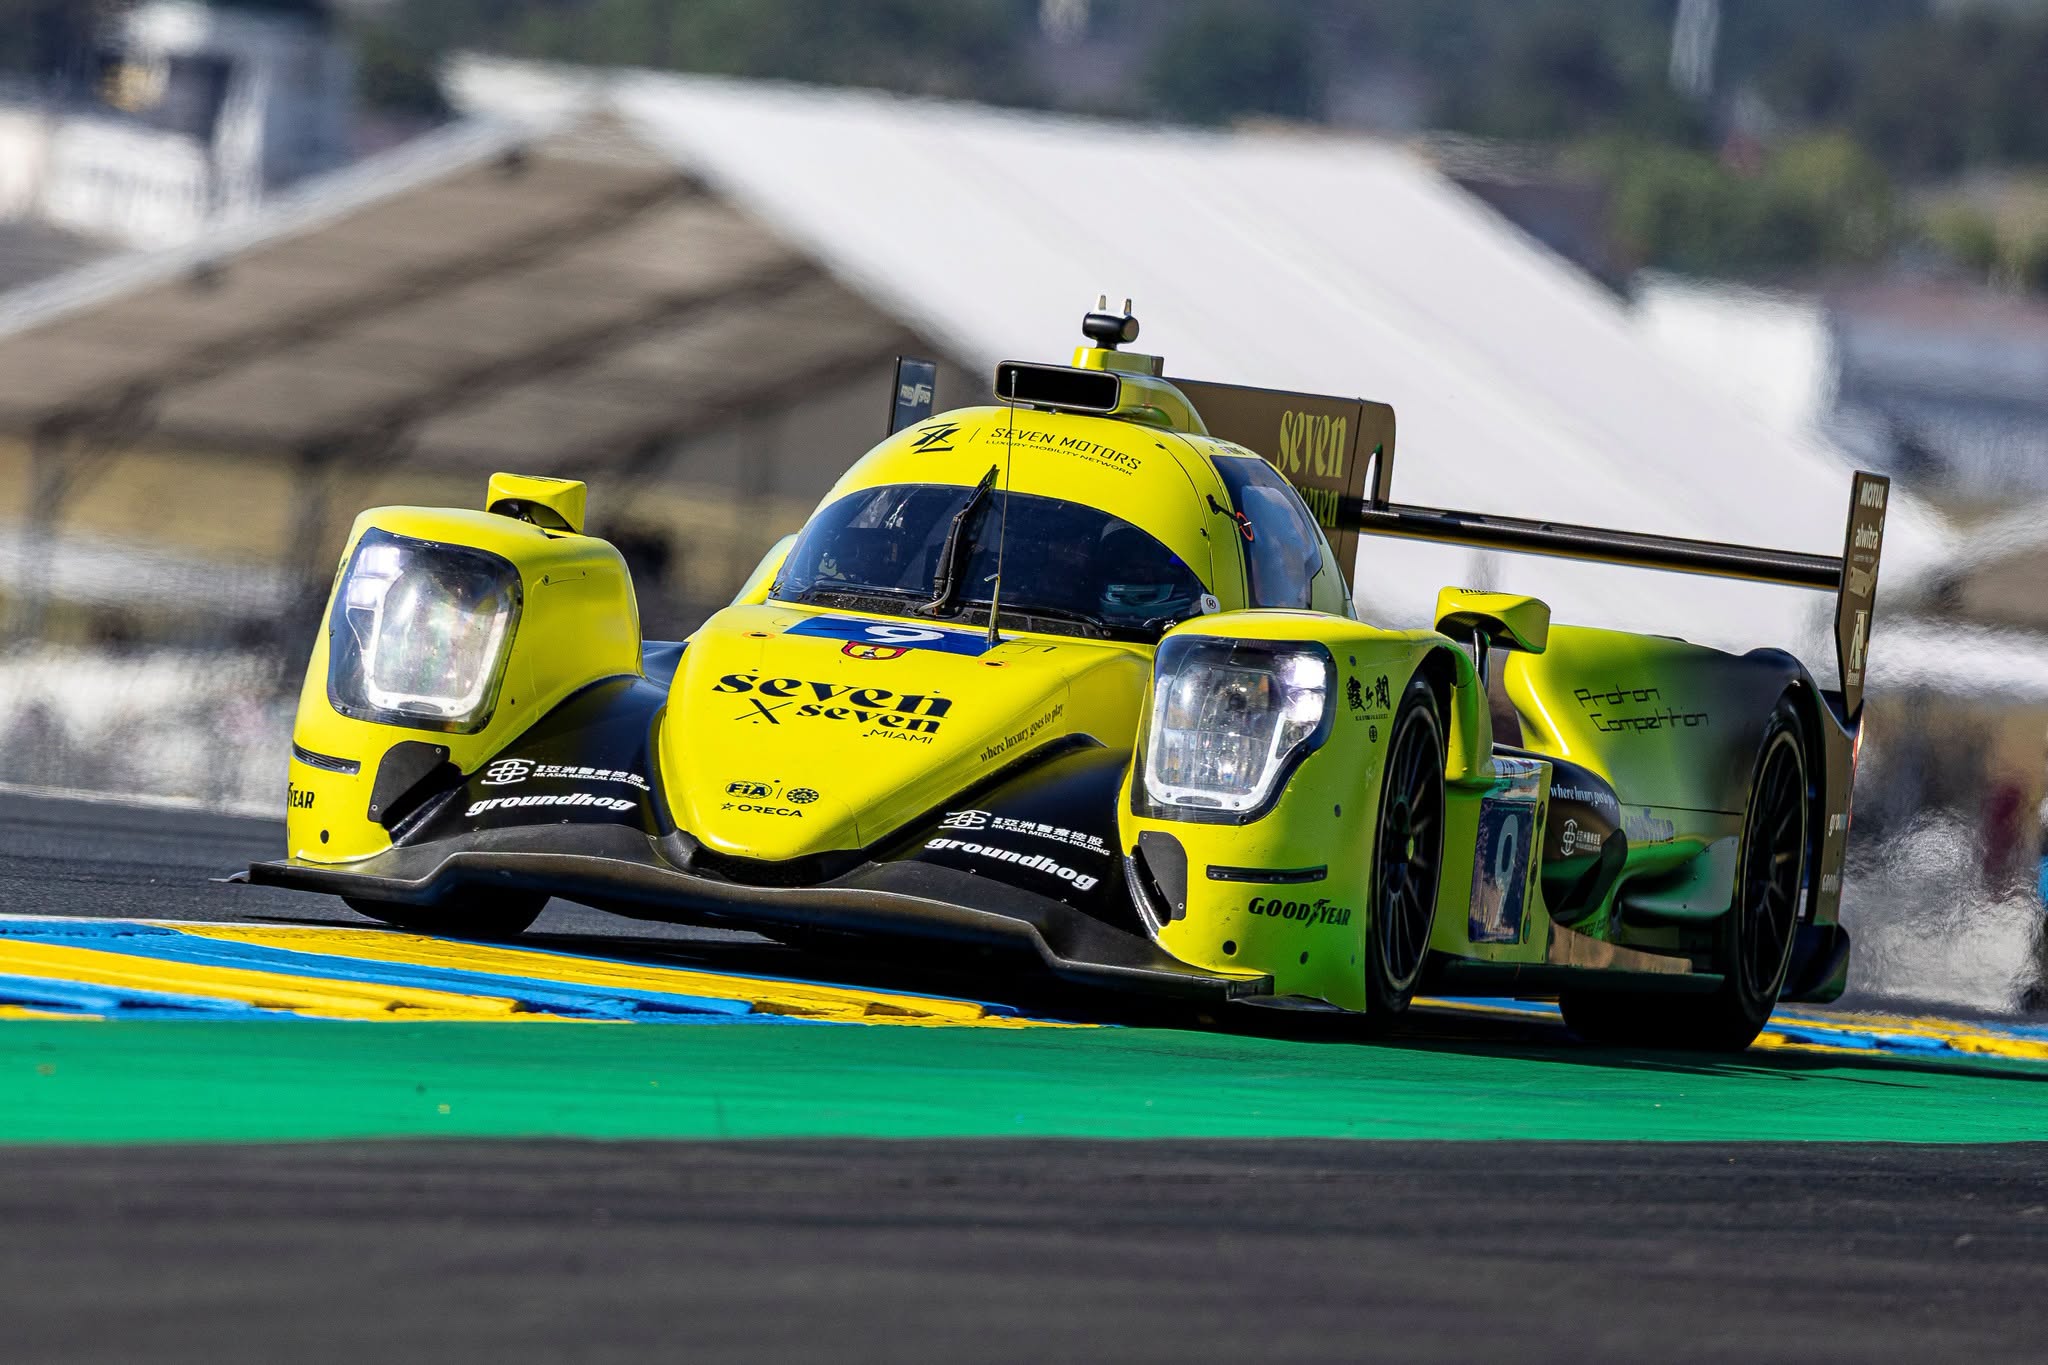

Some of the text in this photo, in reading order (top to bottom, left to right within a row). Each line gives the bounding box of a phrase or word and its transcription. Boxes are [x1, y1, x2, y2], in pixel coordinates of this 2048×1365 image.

[991, 428, 1142, 470] SEVEN MOTORS
[1276, 410, 1346, 478] seven
[1030, 444, 1079, 457] MOBILITY
[1079, 454, 1133, 476] NETWORK
[1859, 481, 1885, 509] MOTUL
[1855, 522, 1879, 550] alwitra
[865, 625, 945, 643] 9
[711, 673, 953, 719] seven
[1574, 683, 1661, 708] Proton
[796, 704, 941, 734] seven
[980, 742, 1005, 762] where
[1004, 727, 1029, 749] luxury
[1030, 717, 1044, 737] goes
[1052, 704, 1064, 723] play
[1589, 706, 1709, 735] Competition
[869, 729, 933, 745] MIAMI
[609, 777, 651, 791] HOLDING
[728, 783, 766, 796] FIA
[1550, 783, 1574, 800] where
[464, 793, 637, 817] groundhog
[738, 804, 803, 818] ORECA
[1005, 826, 1027, 834] ASIA
[1028, 830, 1068, 843] MEDICAL
[1069, 840, 1111, 856] HOLDING
[924, 837, 1099, 892] groundhog
[1492, 814, 1519, 929] 9
[1248, 897, 1351, 927] GOODYEAR
